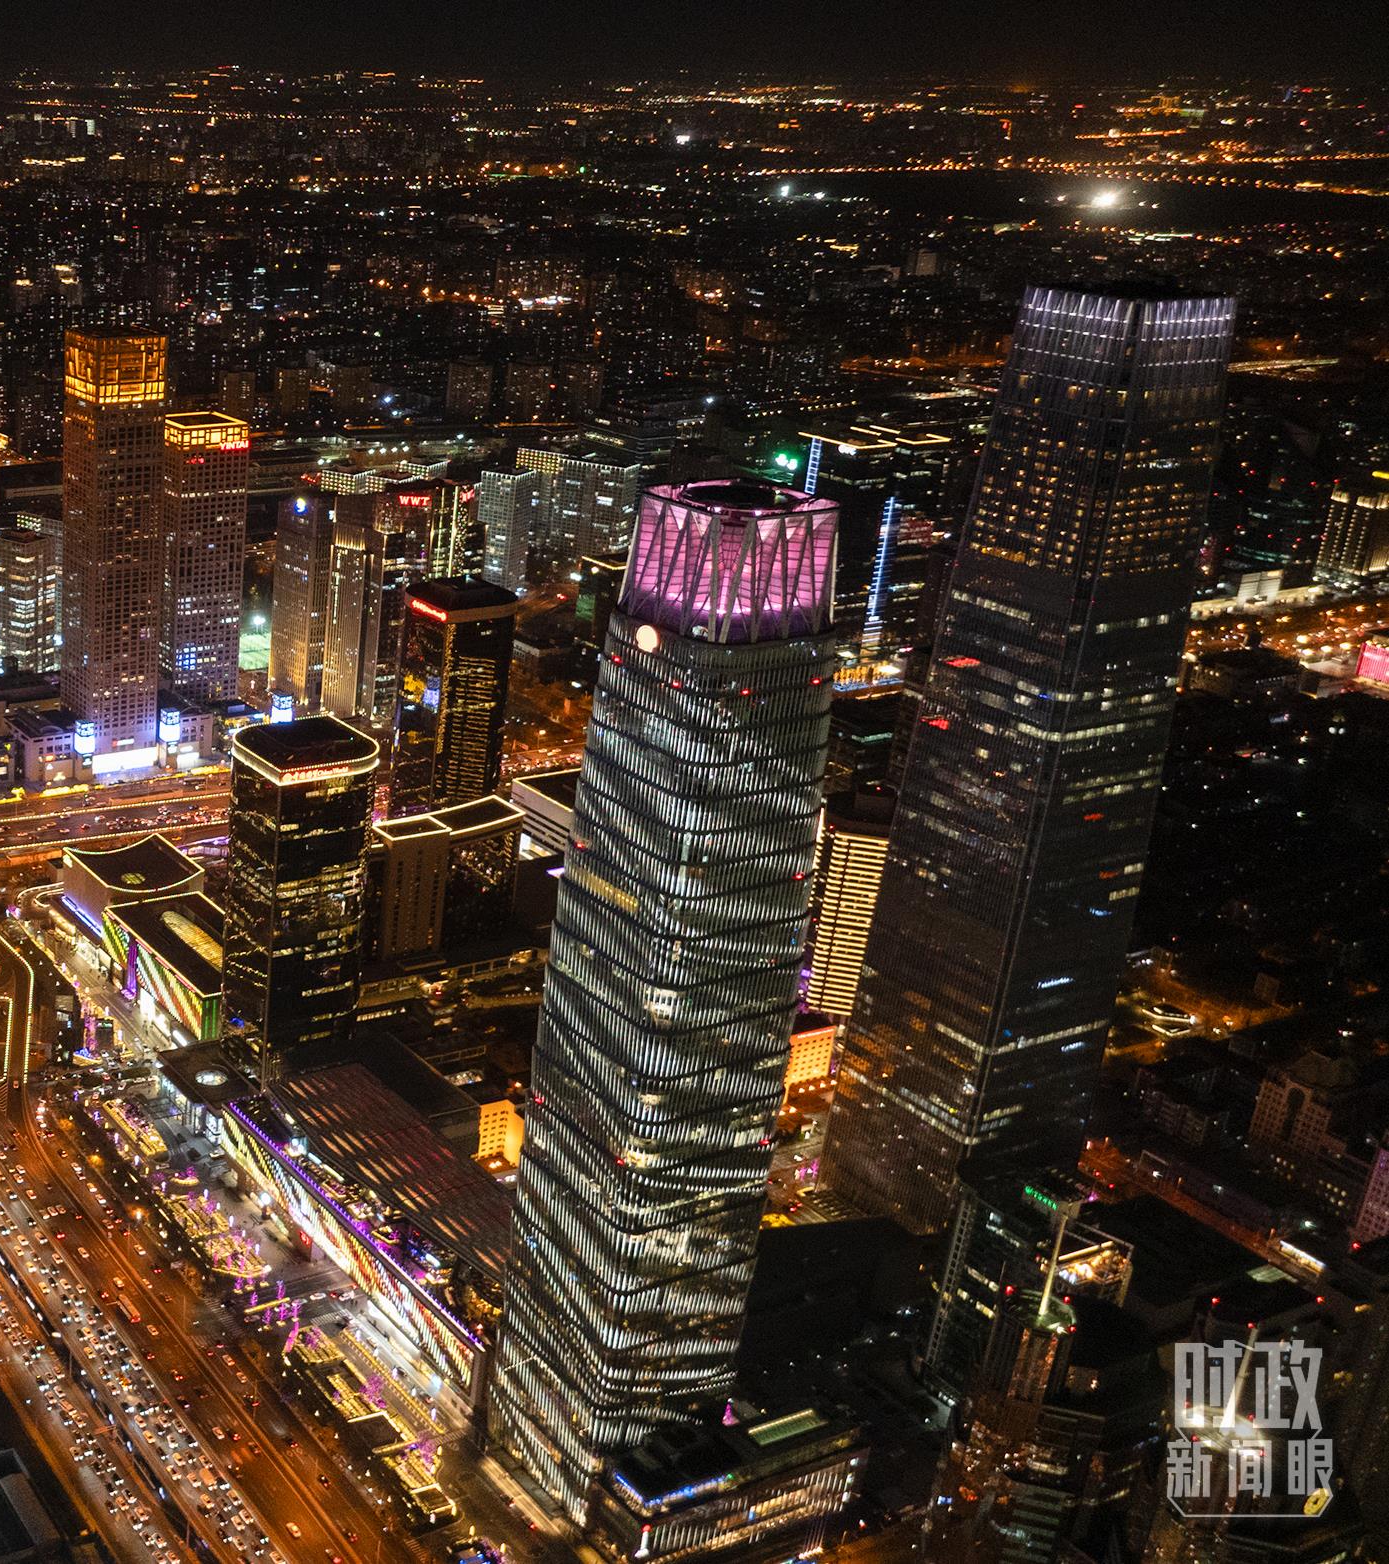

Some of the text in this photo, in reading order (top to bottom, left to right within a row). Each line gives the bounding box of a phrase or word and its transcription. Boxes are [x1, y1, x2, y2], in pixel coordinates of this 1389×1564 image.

[220, 440, 249, 450] YINTAI
[317, 769, 333, 777] China
[333, 766, 349, 774] World
